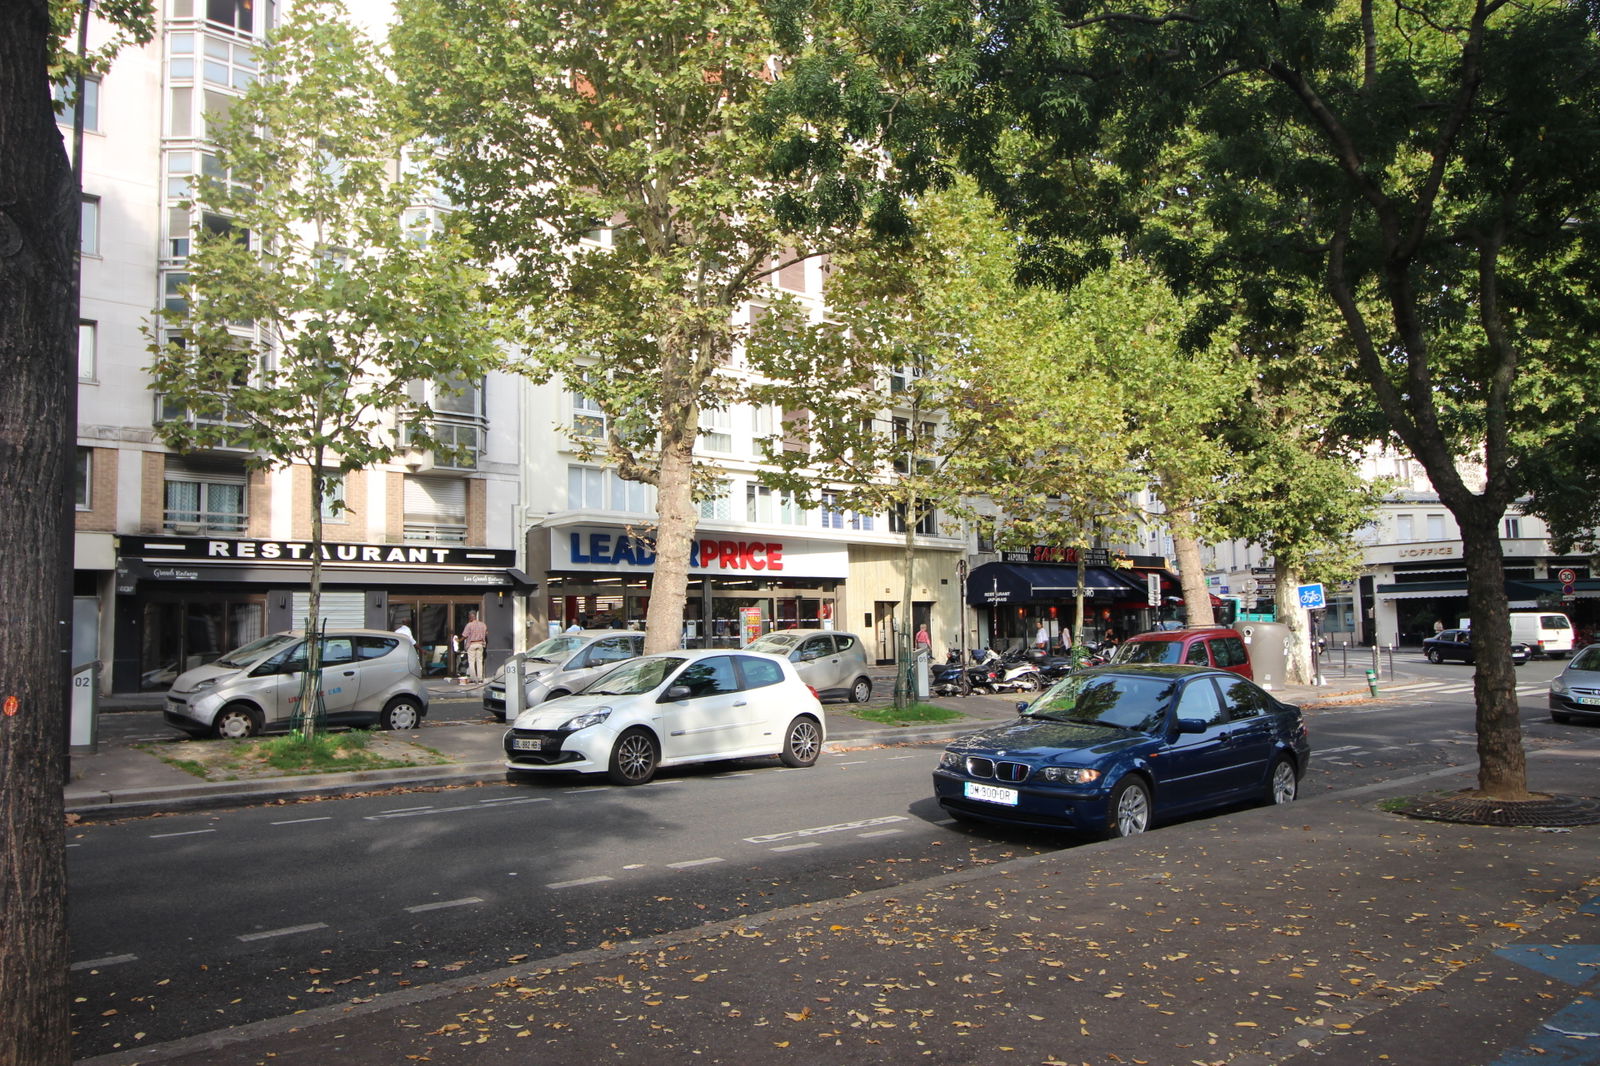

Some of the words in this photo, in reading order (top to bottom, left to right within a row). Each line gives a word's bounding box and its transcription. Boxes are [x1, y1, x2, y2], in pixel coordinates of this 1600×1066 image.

[208, 541, 450, 563] RESTAURANT
[570, 533, 700, 567] LEADR
[700, 540, 784, 570] PRICE
[506, 666, 516, 674] 03
[75, 677, 90, 687] 02
